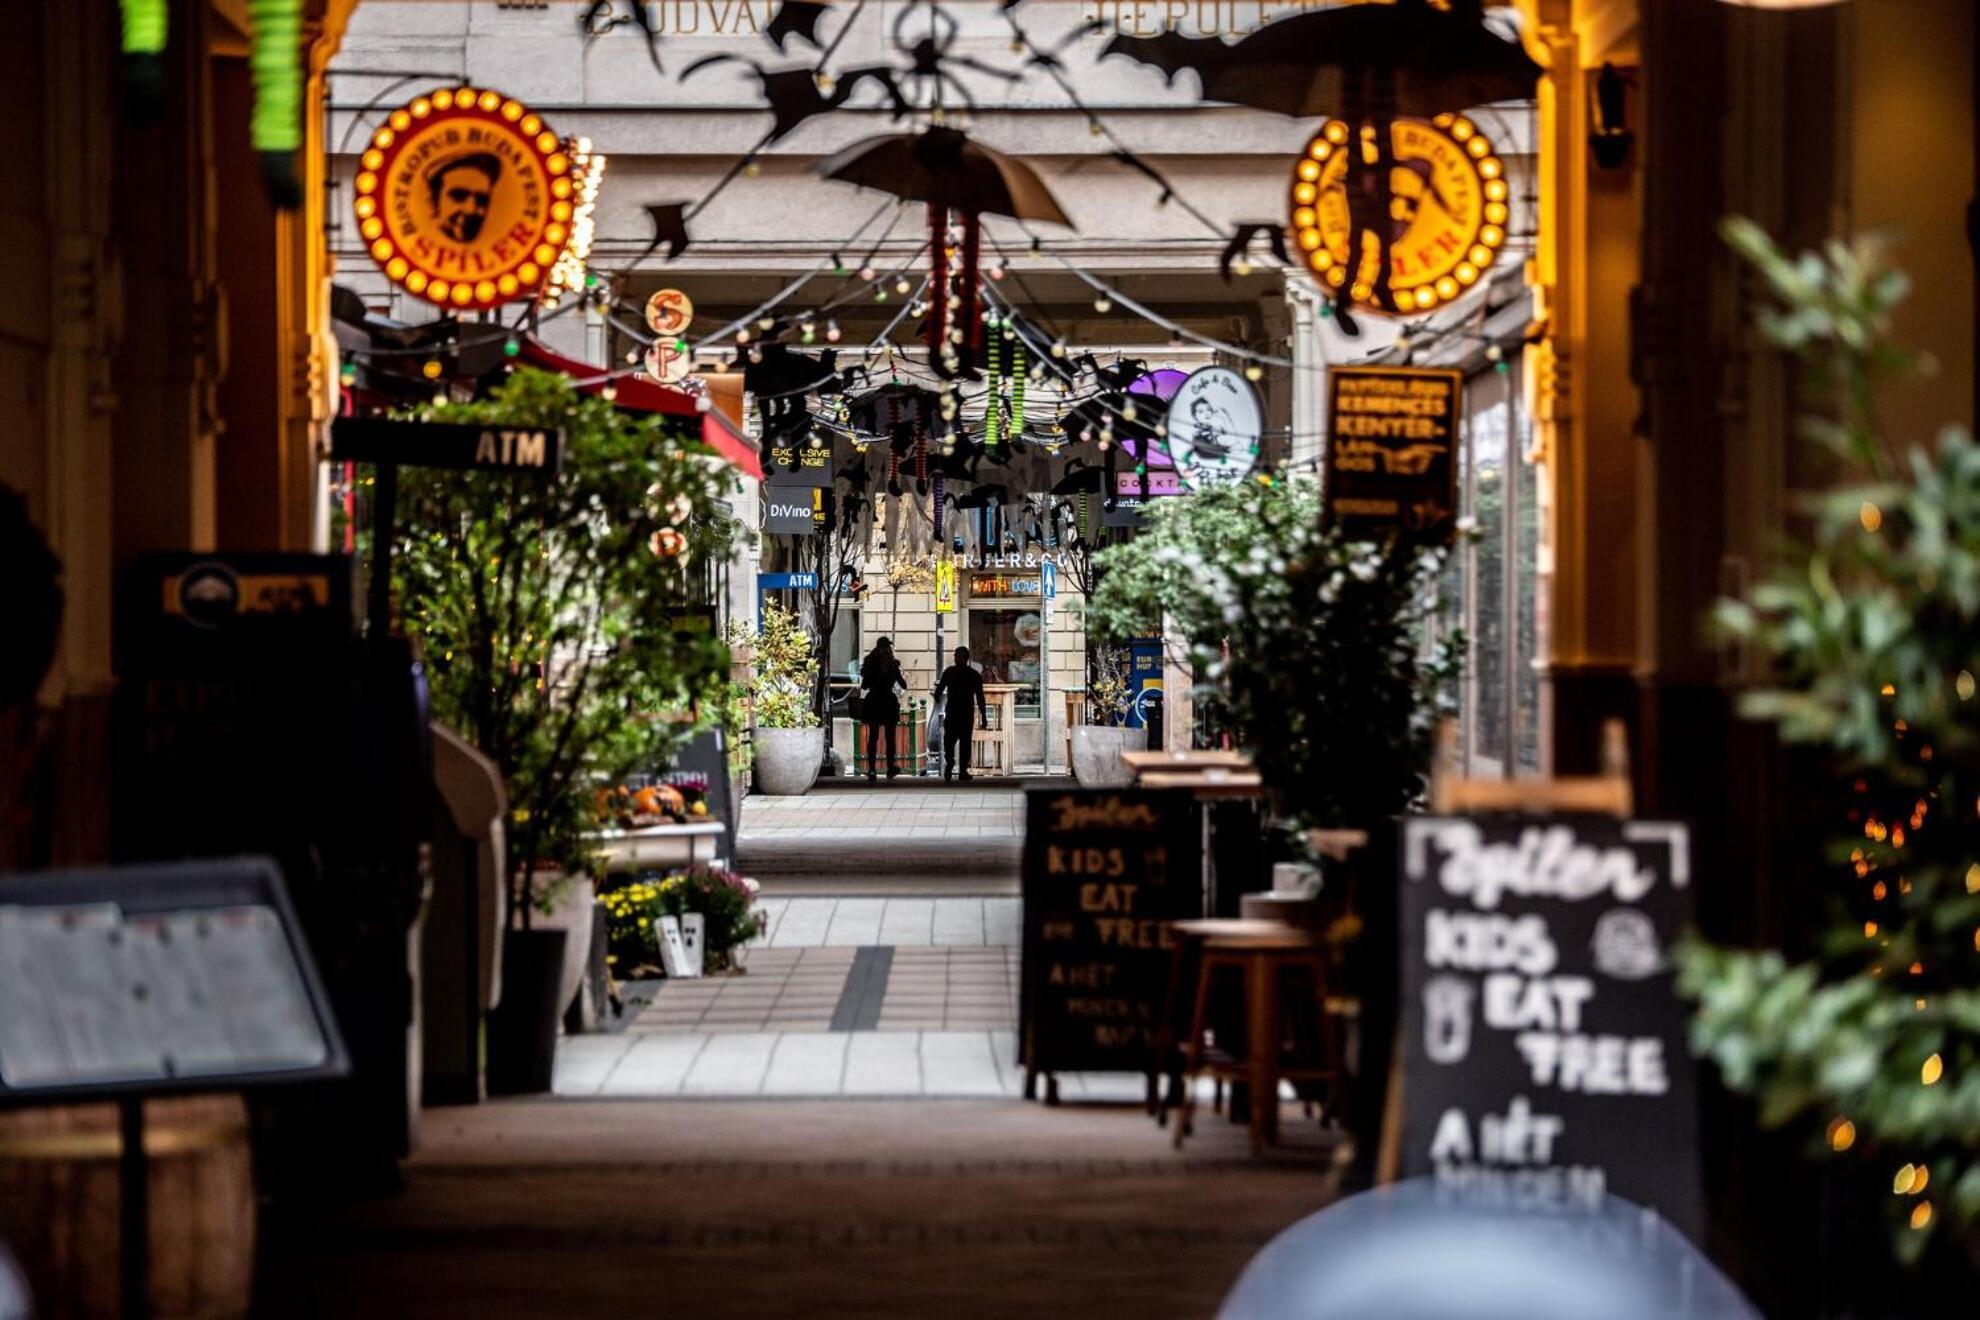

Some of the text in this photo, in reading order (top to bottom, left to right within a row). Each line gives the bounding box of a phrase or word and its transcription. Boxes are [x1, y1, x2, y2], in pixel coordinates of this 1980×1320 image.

[475, 431, 546, 467] ATM
[778, 457, 825, 467] CHNGE
[771, 503, 811, 519] DiVino
[789, 574, 813, 587] ATM
[1047, 847, 1126, 876] KIDS
[1081, 883, 1139, 912] EAT
[1424, 908, 1558, 975] KIDS
[1482, 972, 1596, 1032] EAT
[1429, 1106, 1473, 1161] A
